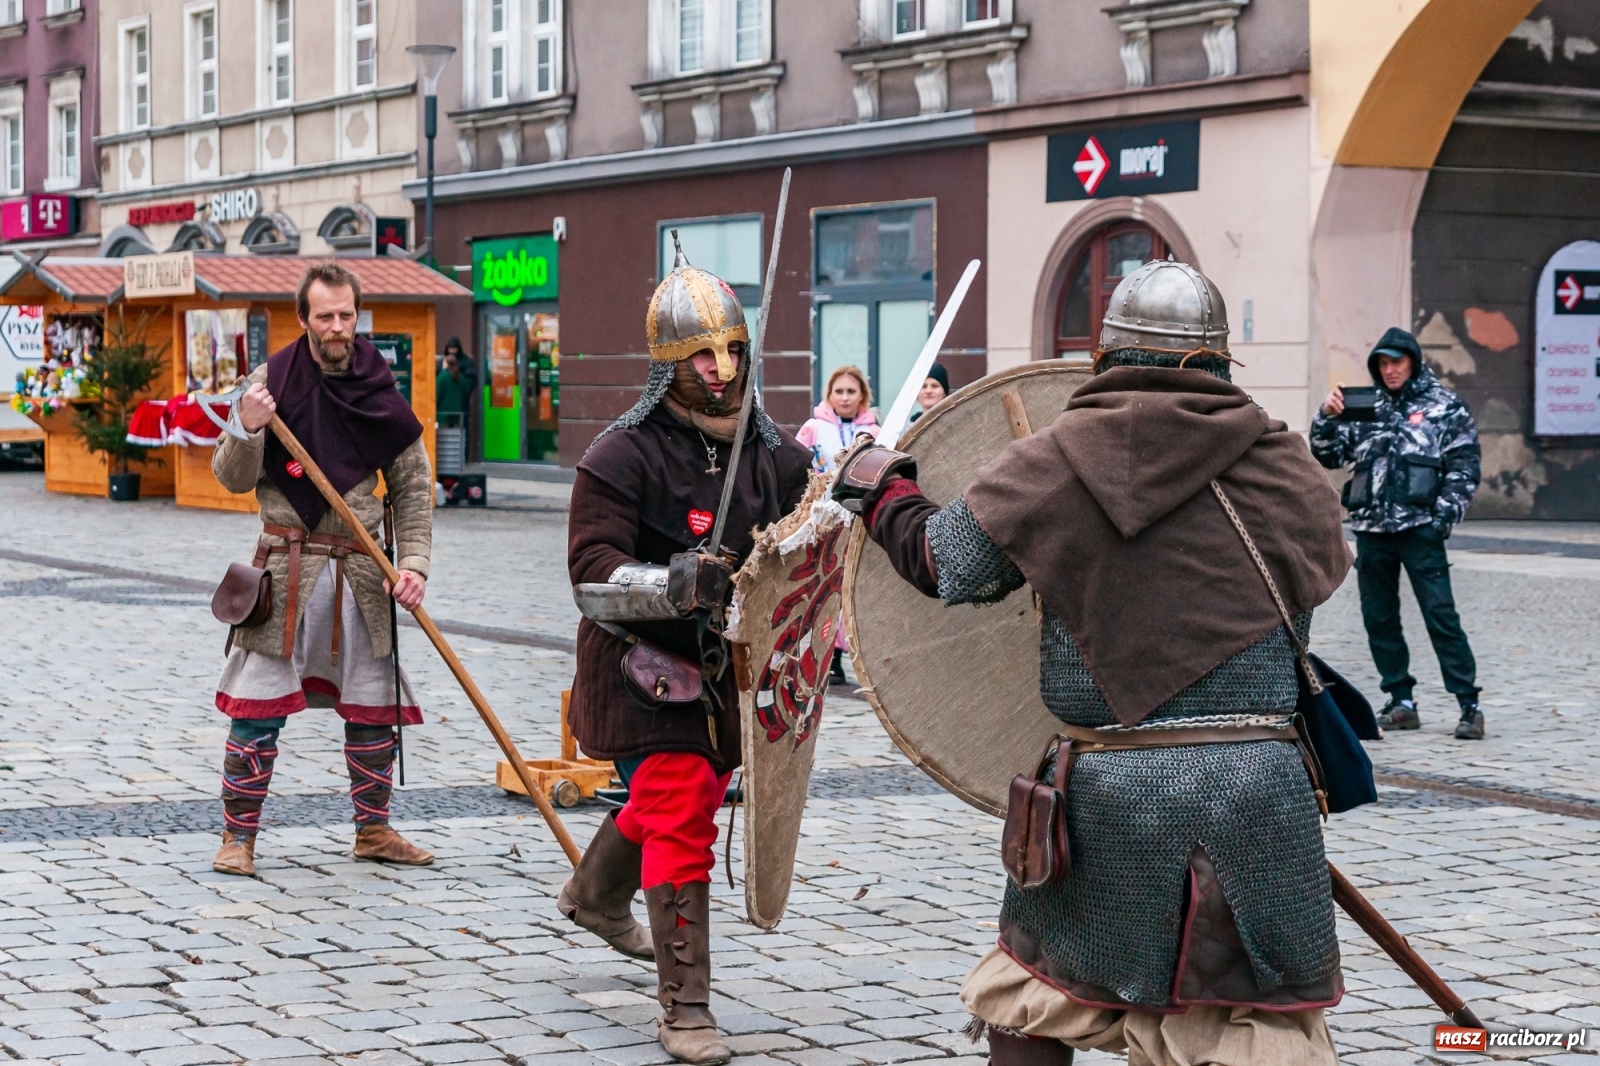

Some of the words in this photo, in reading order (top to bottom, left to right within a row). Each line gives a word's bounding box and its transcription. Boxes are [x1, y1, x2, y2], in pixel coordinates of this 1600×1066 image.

[1119, 138, 1165, 177] moraj
[39, 199, 62, 230] T
[211, 188, 258, 222] SHIRO
[482, 249, 548, 289] żabka
[8, 321, 44, 335] PYSZ
